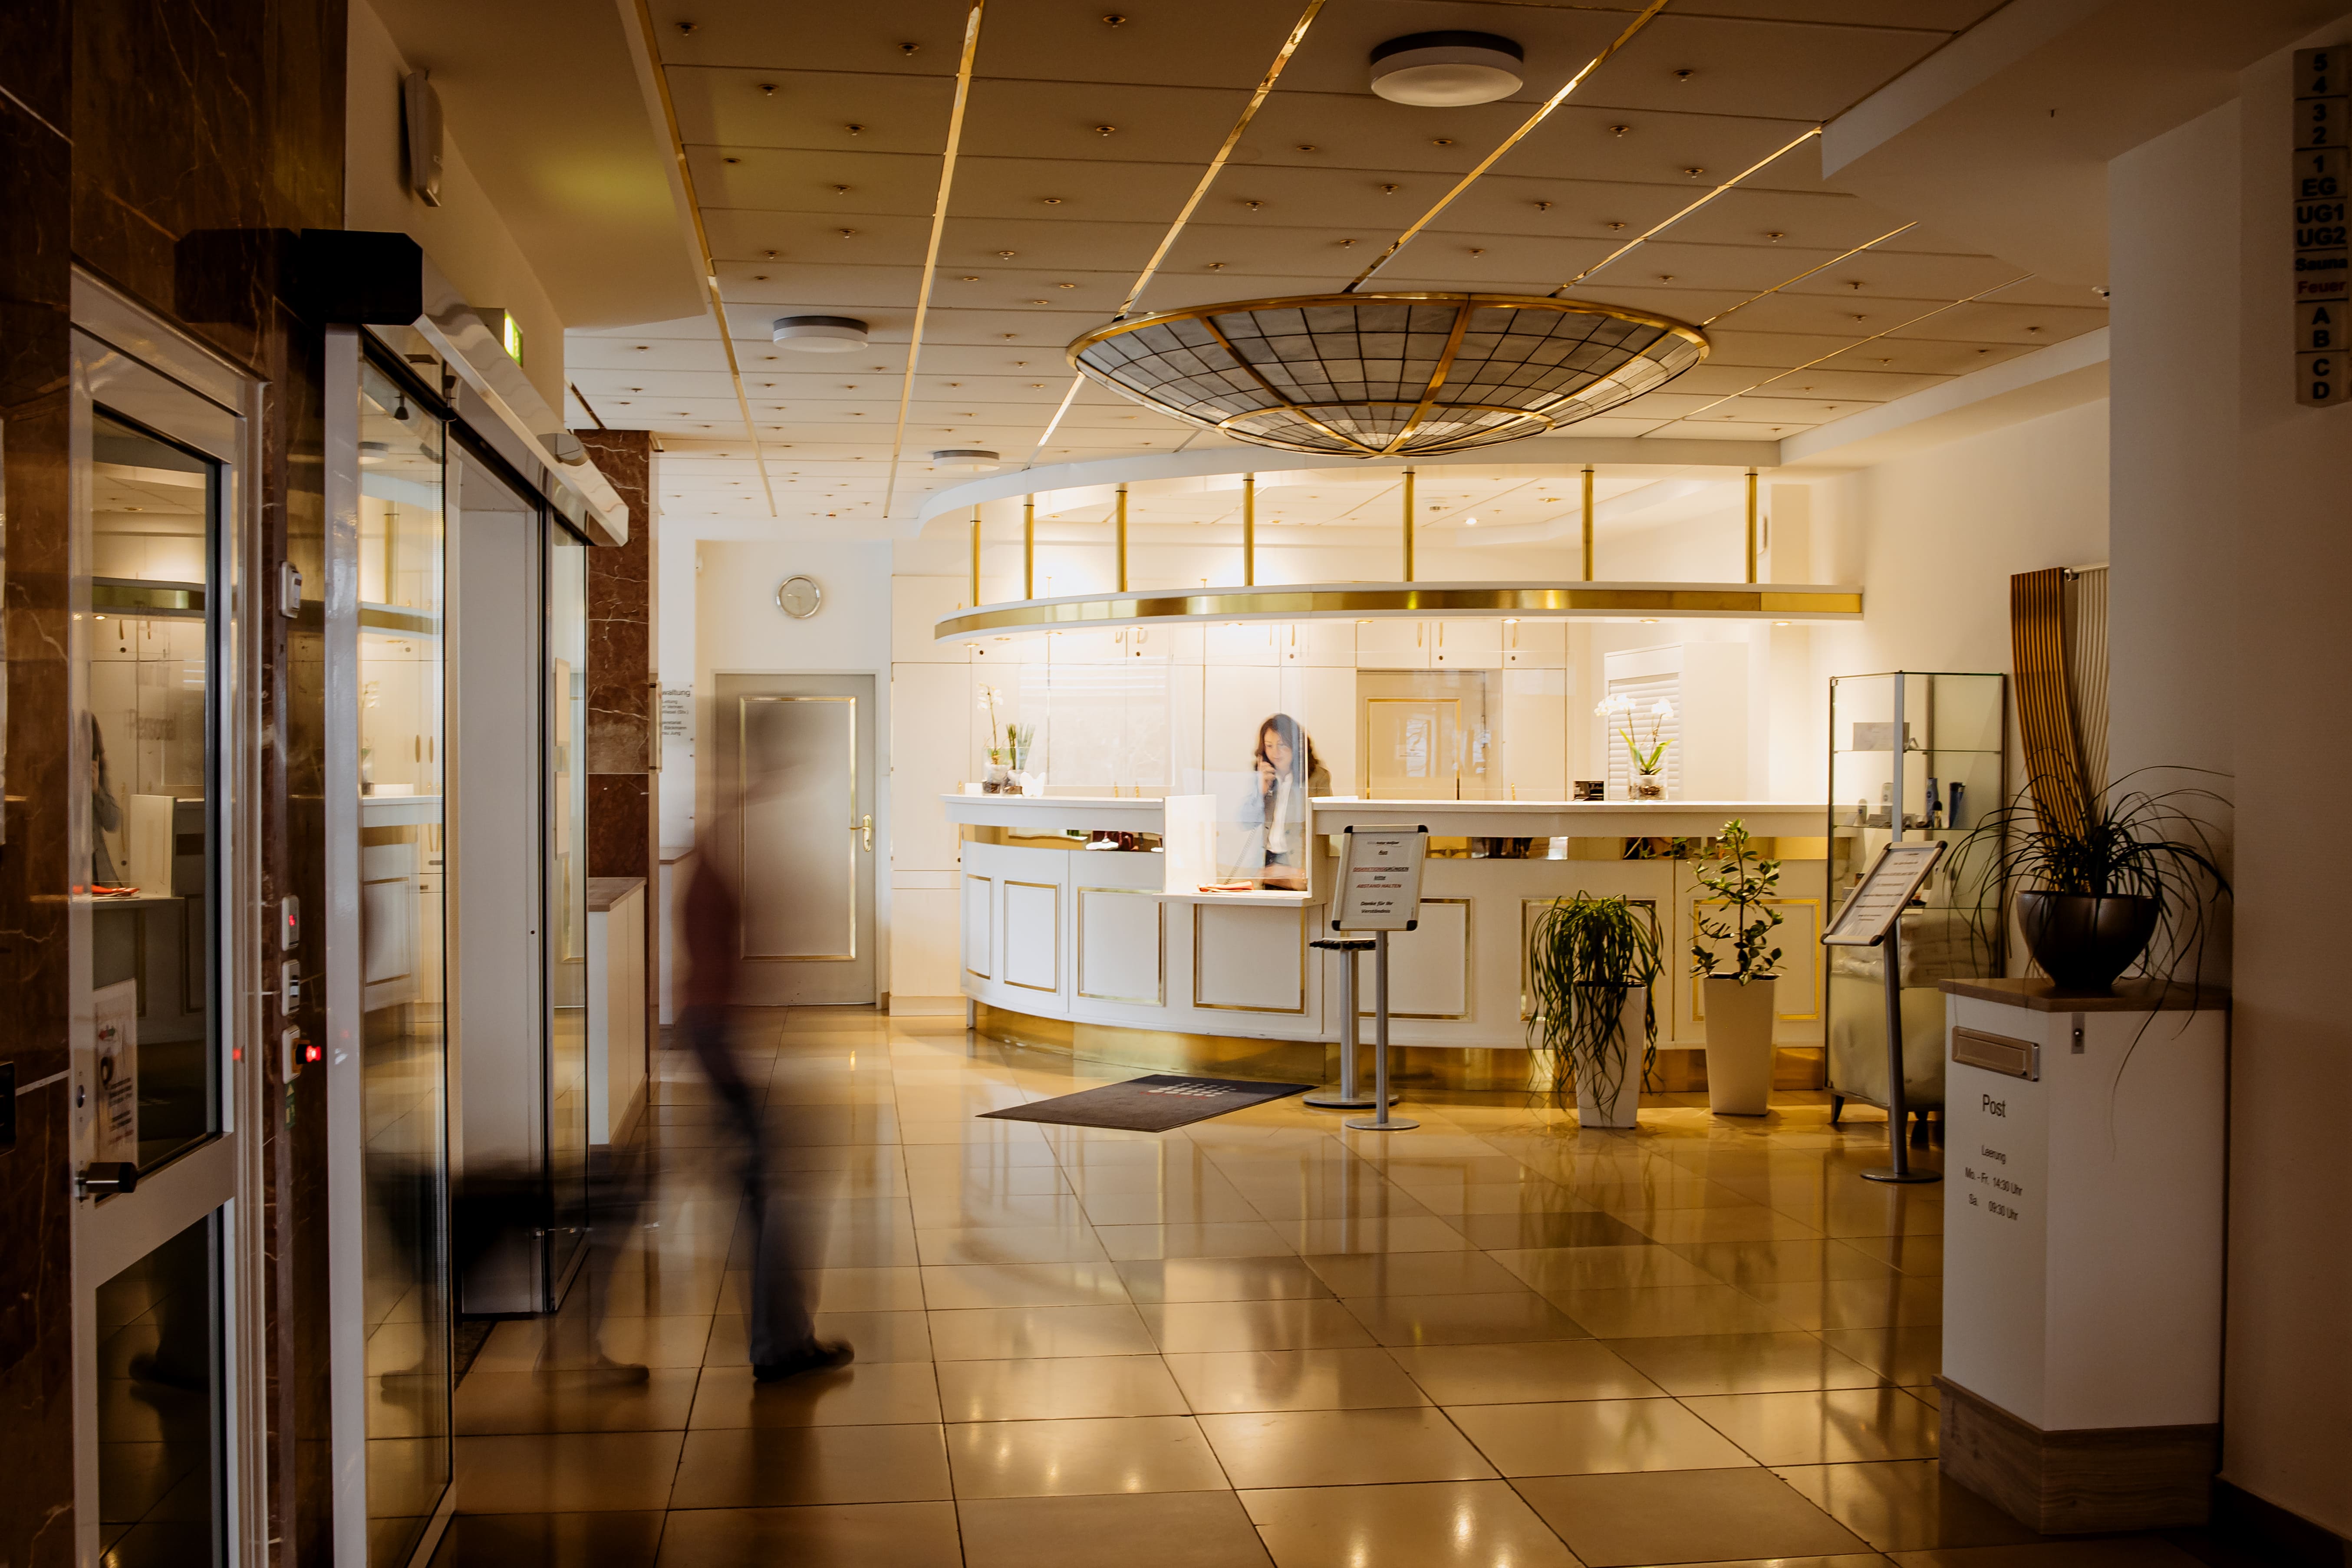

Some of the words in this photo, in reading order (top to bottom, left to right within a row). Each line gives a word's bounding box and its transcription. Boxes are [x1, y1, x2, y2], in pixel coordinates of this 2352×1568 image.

[2314, 53, 2327, 71] 5
[2312, 76, 2327, 93] 4
[2313, 104, 2326, 121] 3
[2313, 126, 2326, 144] 2
[2313, 155, 2323, 173] 1
[2302, 177, 2336, 197] EG
[2297, 204, 2344, 224] UG1
[2298, 227, 2346, 246] UG2
[2296, 258, 2348, 271] Sauna
[2298, 280, 2346, 294] Feuer
[2312, 307, 2330, 325] A
[2314, 330, 2329, 348] B
[2313, 359, 2329, 376] C
[2313, 382, 2329, 399] D
[1982, 1094, 2006, 1118] Post
[1981, 1145, 2006, 1165] Leerung
[1993, 1177, 2009, 1192] 14:30
[2010, 1183, 2023, 1196] Uhr
[1988, 1200, 2006, 1216] 09:30
[2007, 1207, 2019, 1220] Uhr
